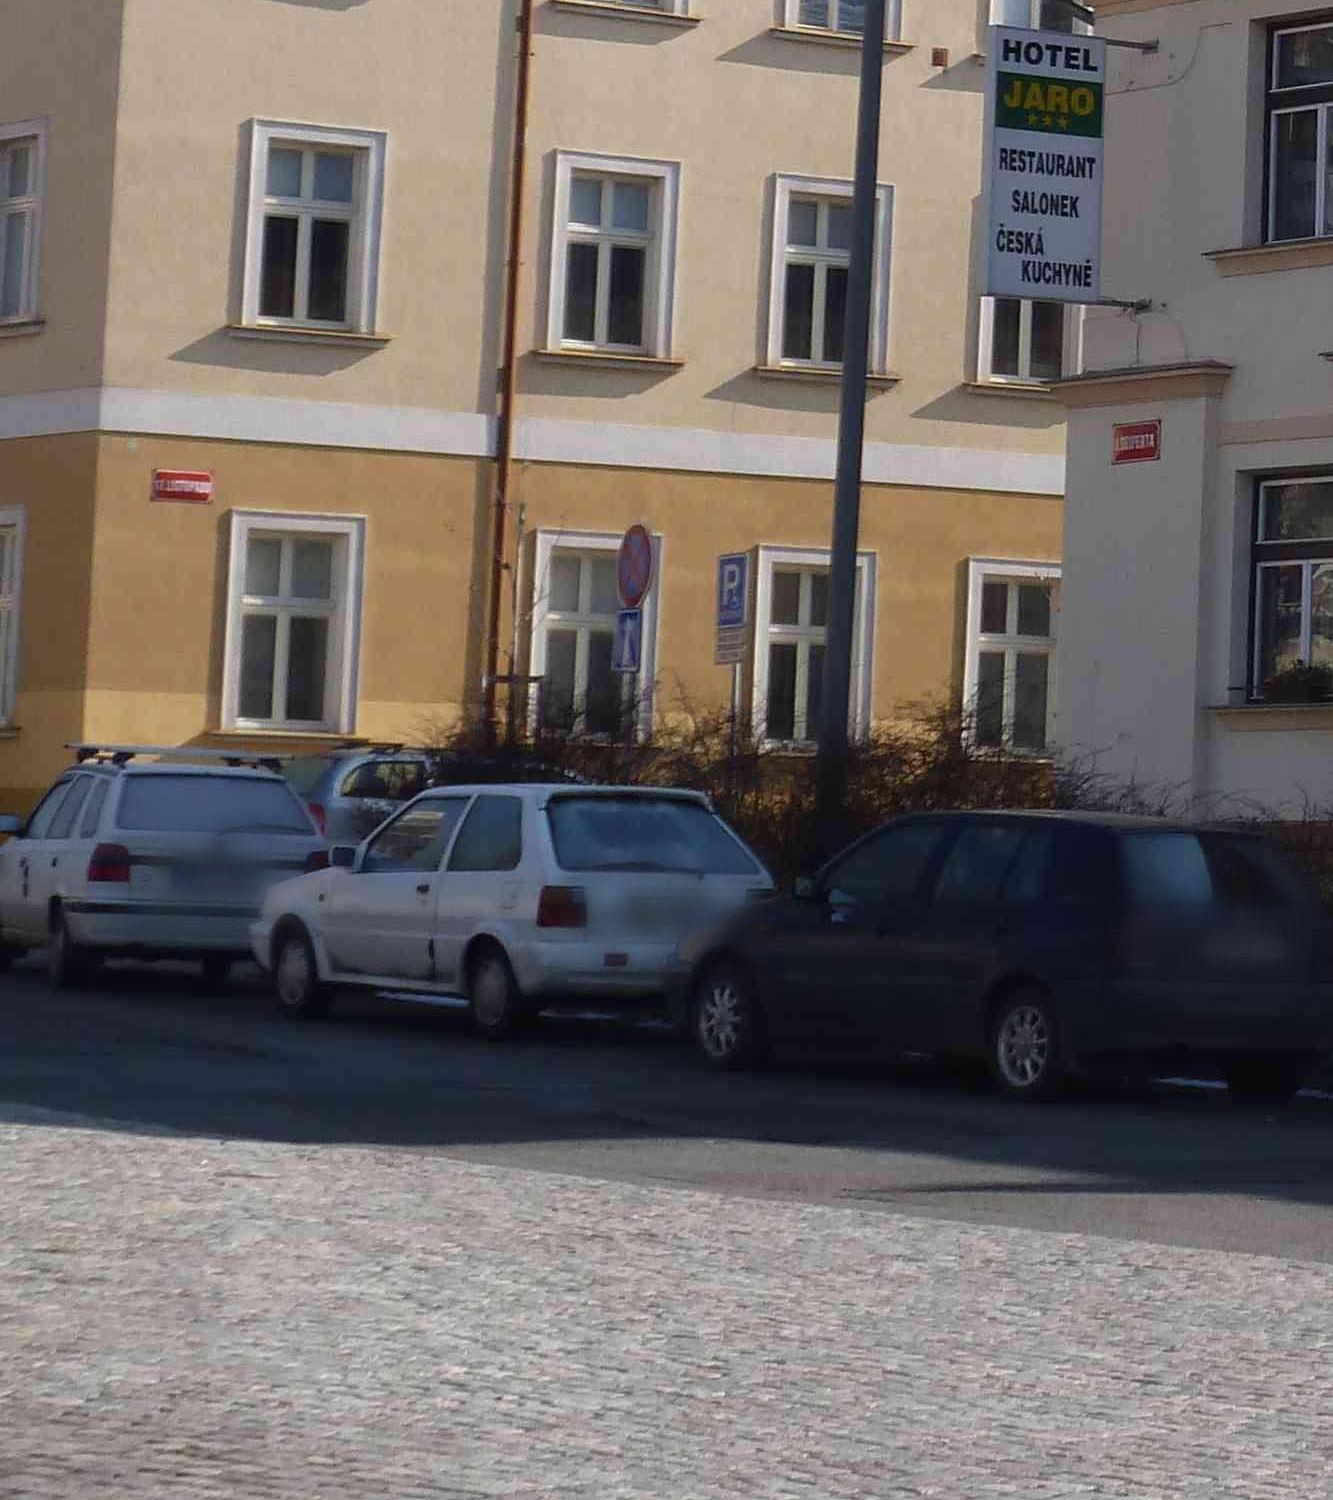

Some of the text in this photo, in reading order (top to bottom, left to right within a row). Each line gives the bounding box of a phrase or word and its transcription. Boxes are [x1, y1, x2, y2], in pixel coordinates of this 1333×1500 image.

[1003, 38, 1098, 72] HOTEL
[1004, 80, 1095, 116] JARO
[1000, 148, 1096, 179] RESTAURANT
[1011, 189, 1080, 218] SALONEK
[996, 223, 1044, 255] ČESKÁ
